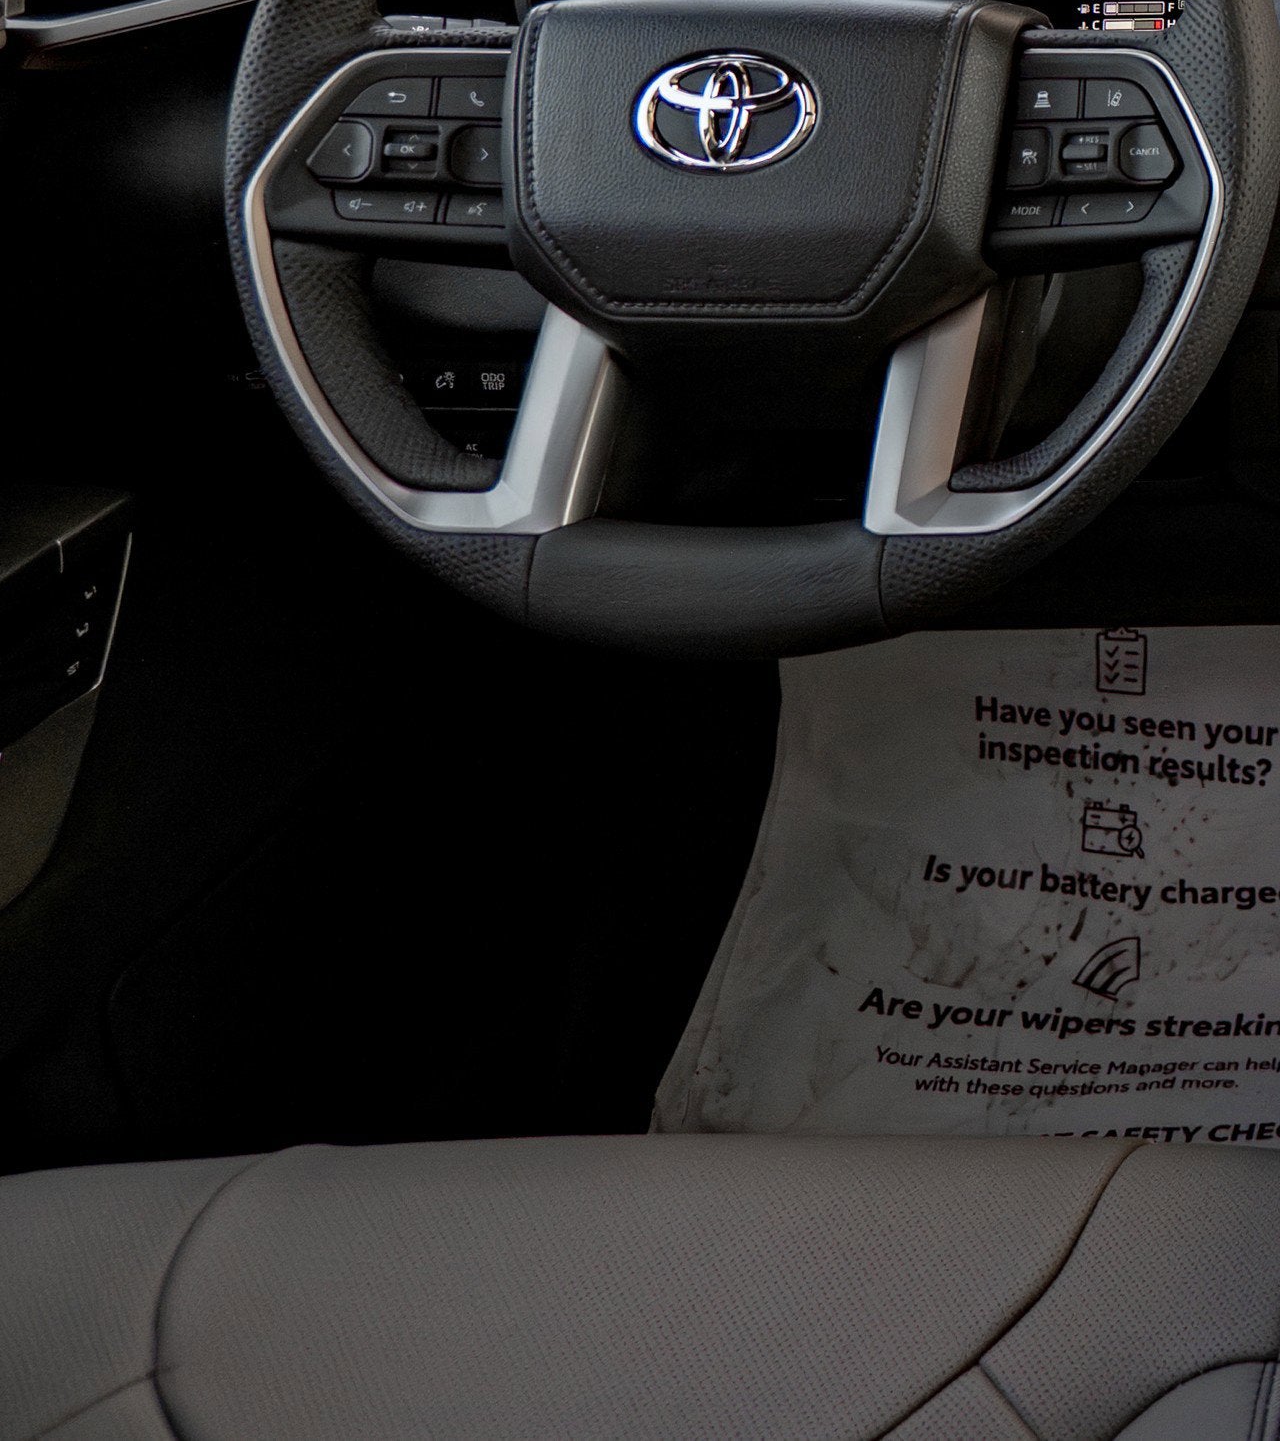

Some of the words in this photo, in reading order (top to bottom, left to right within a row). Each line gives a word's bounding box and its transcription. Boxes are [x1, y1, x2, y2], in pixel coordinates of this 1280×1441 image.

[1092, 3, 1101, 15] E
[1167, 3, 1176, 14] F
[400, 145, 416, 154] OK
[1128, 147, 1161, 156] CANCEL
[1010, 205, 1042, 216] MODE
[480, 372, 506, 382] ODO
[481, 382, 506, 391] TRIP
[975, 696, 1052, 726] Have
[1059, 708, 1116, 736] you
[1124, 713, 1196, 740] seen
[1204, 723, 1279, 750] your
[978, 732, 1139, 774] inspection
[1149, 754, 1272, 787] results?
[923, 853, 951, 886] Is
[956, 863, 1034, 893] your
[1039, 863, 1152, 911] battery
[858, 987, 924, 1020] Are
[927, 1003, 1013, 1029] your
[1021, 1005, 1136, 1039] wipers
[875, 1044, 924, 1068] Your
[926, 1052, 1023, 1074] Assistant
[1027, 1058, 1101, 1075] Service
[1107, 1058, 1199, 1077] Manager
[1203, 1059, 1240, 1072] can
[914, 1075, 959, 1094] with
[966, 1076, 1023, 1096] these
[1028, 1080, 1130, 1099] questions
[1135, 1076, 1177, 1091] and
[1181, 1078, 1240, 1090] more.
